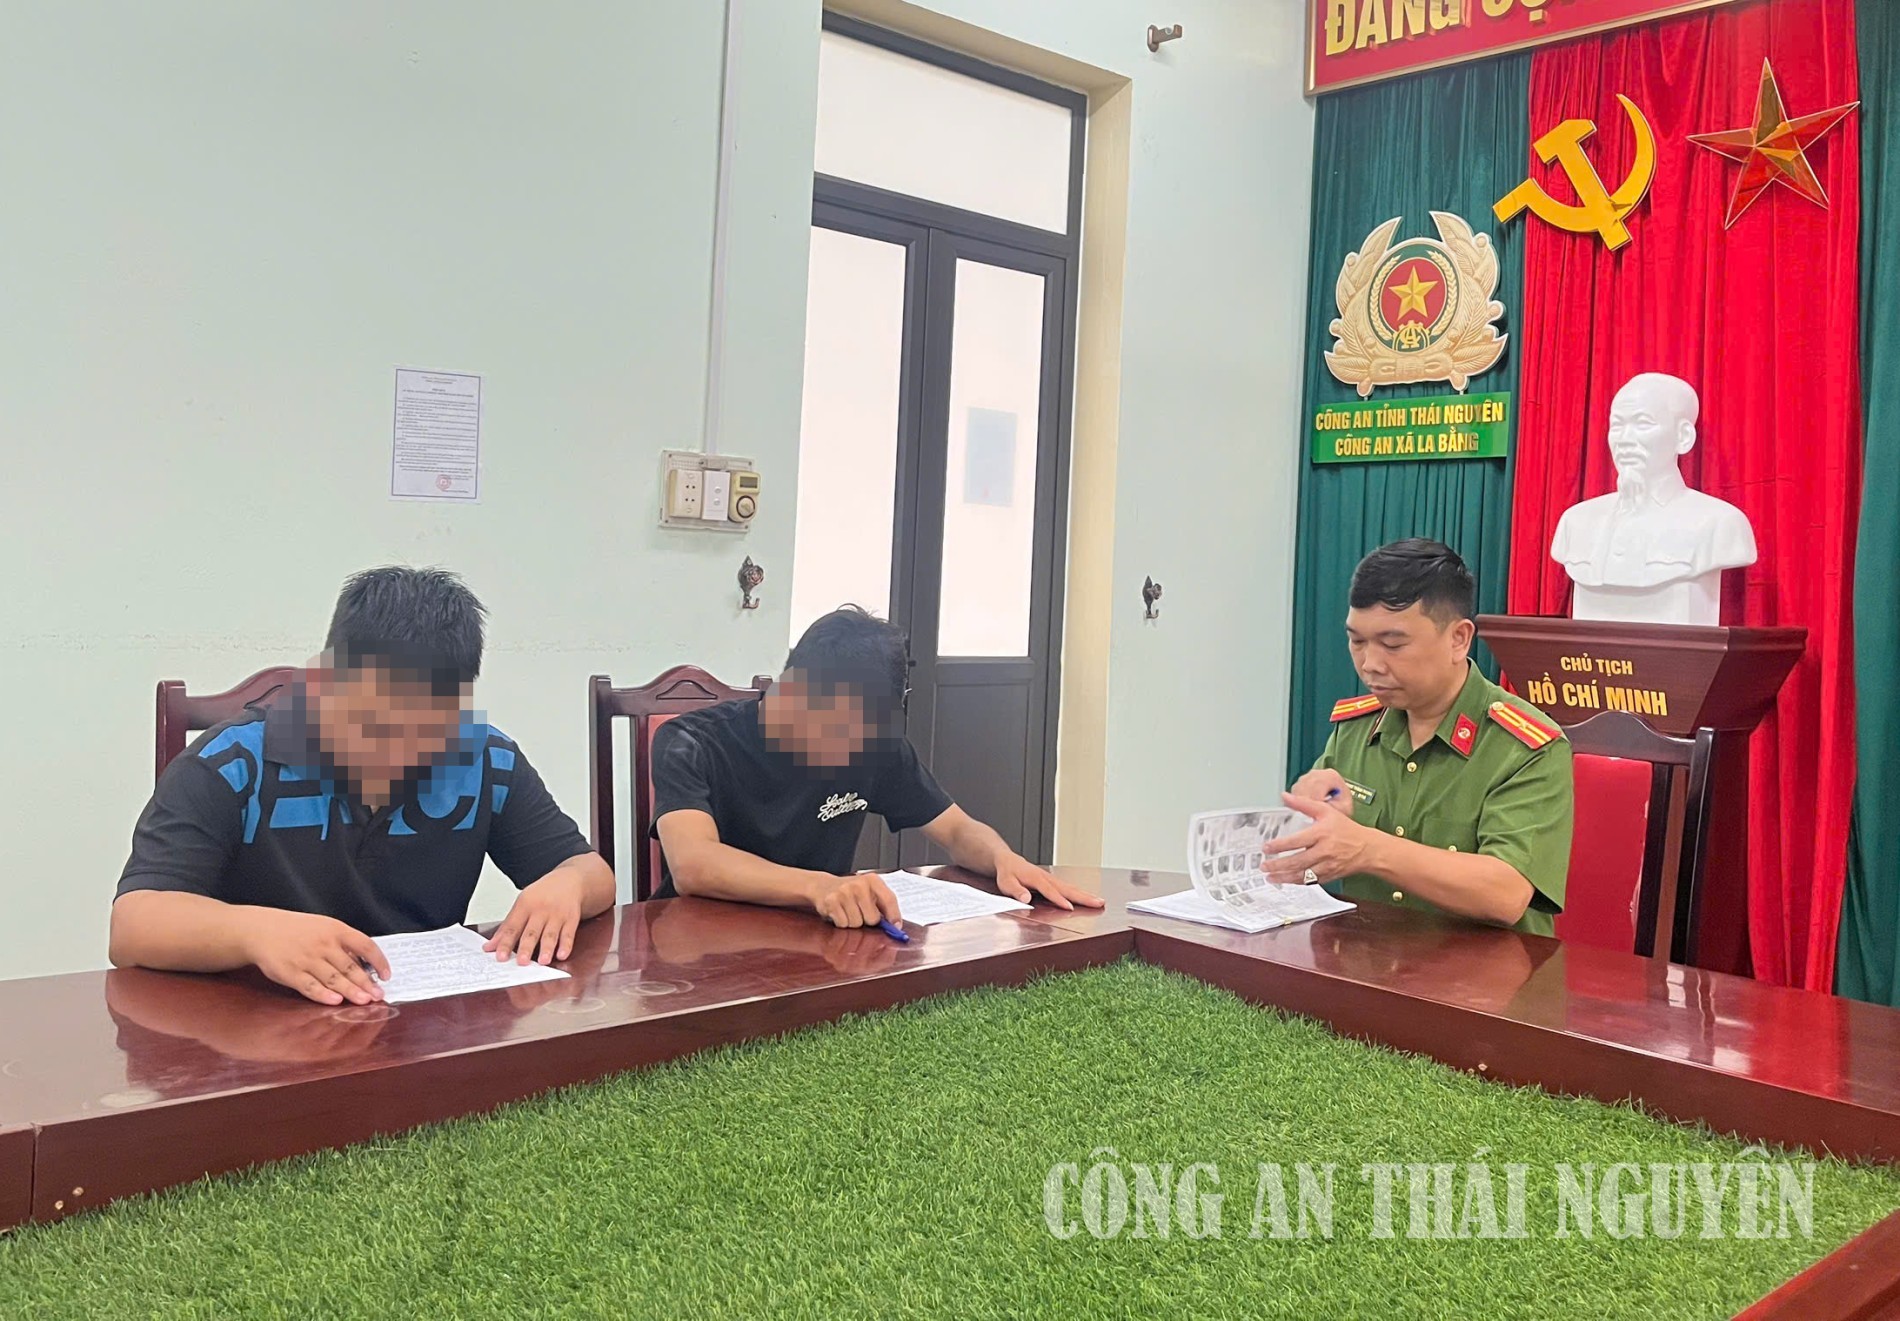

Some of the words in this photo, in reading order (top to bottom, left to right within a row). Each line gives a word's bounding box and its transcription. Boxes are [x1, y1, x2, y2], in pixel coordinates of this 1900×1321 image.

[1316, 409, 1351, 431] CÔNG
[1353, 410, 1372, 429] AN
[1376, 403, 1407, 427] TỈNH
[1410, 403, 1440, 425] THÁI
[1443, 399, 1504, 424] NGUYÊN
[1335, 434, 1371, 456] CÔNG
[1374, 436, 1393, 455] AN
[1396, 431, 1414, 454] XÃ
[1418, 434, 1435, 453] LA
[1438, 425, 1479, 452] BẰNG
[1560, 653, 1592, 672] CHỦ
[1595, 659, 1633, 677] TỊCH
[1528, 672, 1557, 705] HỒ
[1562, 680, 1600, 709] CHÍ
[1605, 686, 1668, 716] MINH
